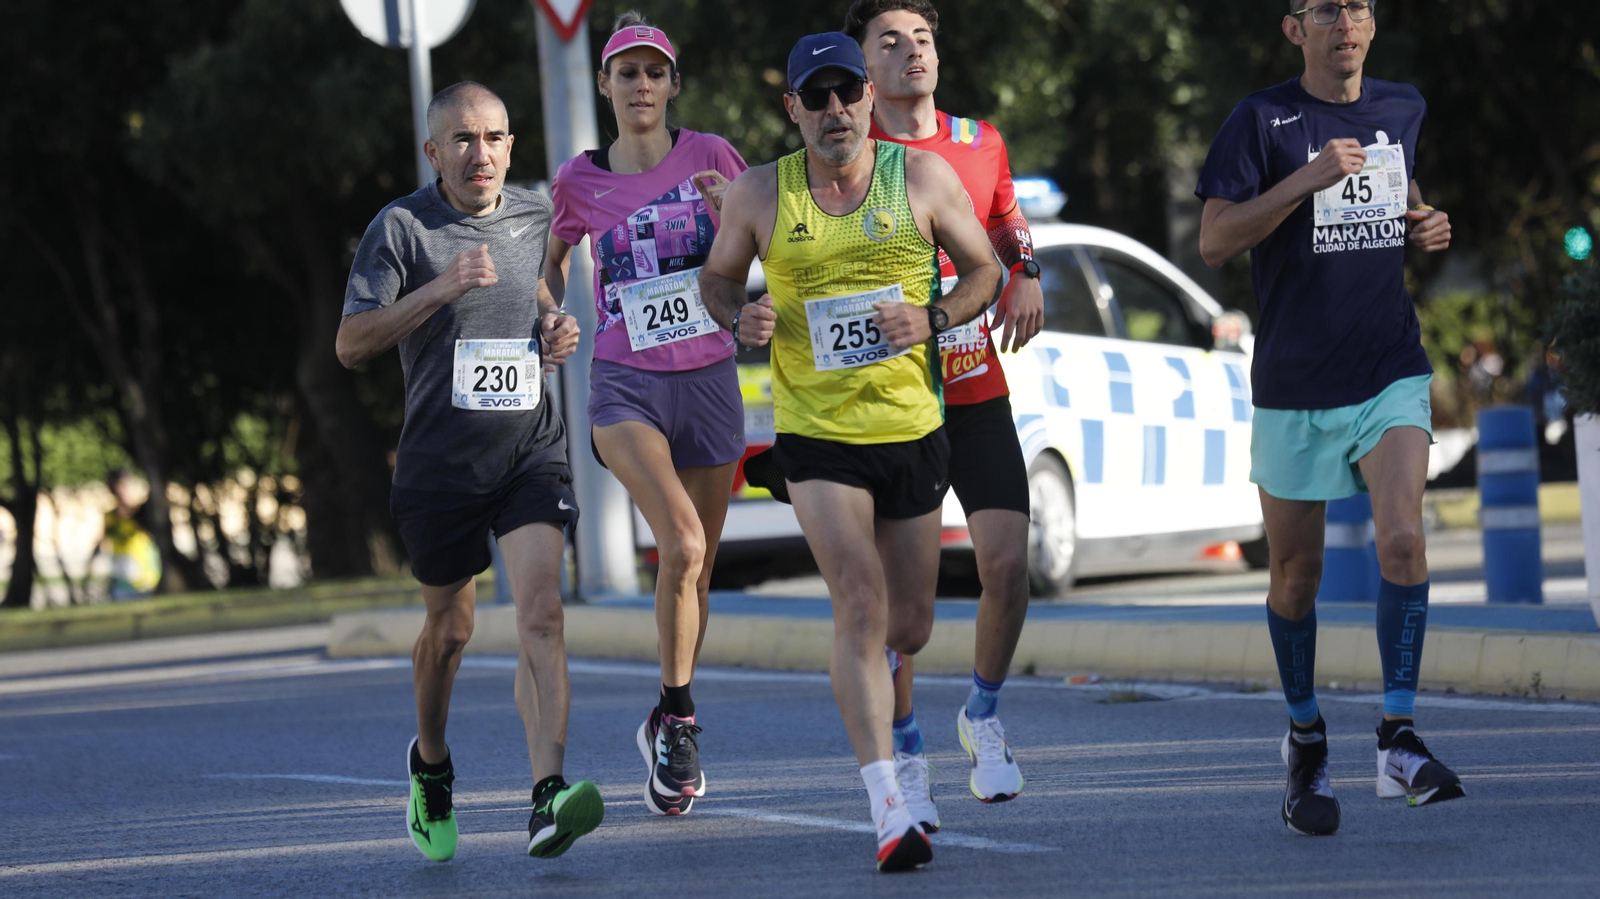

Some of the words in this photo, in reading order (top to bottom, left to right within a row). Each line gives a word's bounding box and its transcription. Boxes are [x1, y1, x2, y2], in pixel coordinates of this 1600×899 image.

[1341, 175, 1373, 205] 45
[1341, 208, 1386, 220] EVOS
[665, 219, 687, 231] NIKE
[1313, 241, 1346, 254] CIUDAD
[1347, 240, 1360, 250] DE
[1362, 237, 1405, 249] ALGECIRAS
[669, 257, 685, 267] NIKE
[792, 259, 900, 285] RUTEROS
[643, 297, 689, 331] 249
[655, 326, 698, 342] EVOS
[829, 317, 881, 351] 255
[841, 348, 889, 365] EVOS
[472, 365, 518, 393] 230
[478, 398, 521, 407] EVOS
